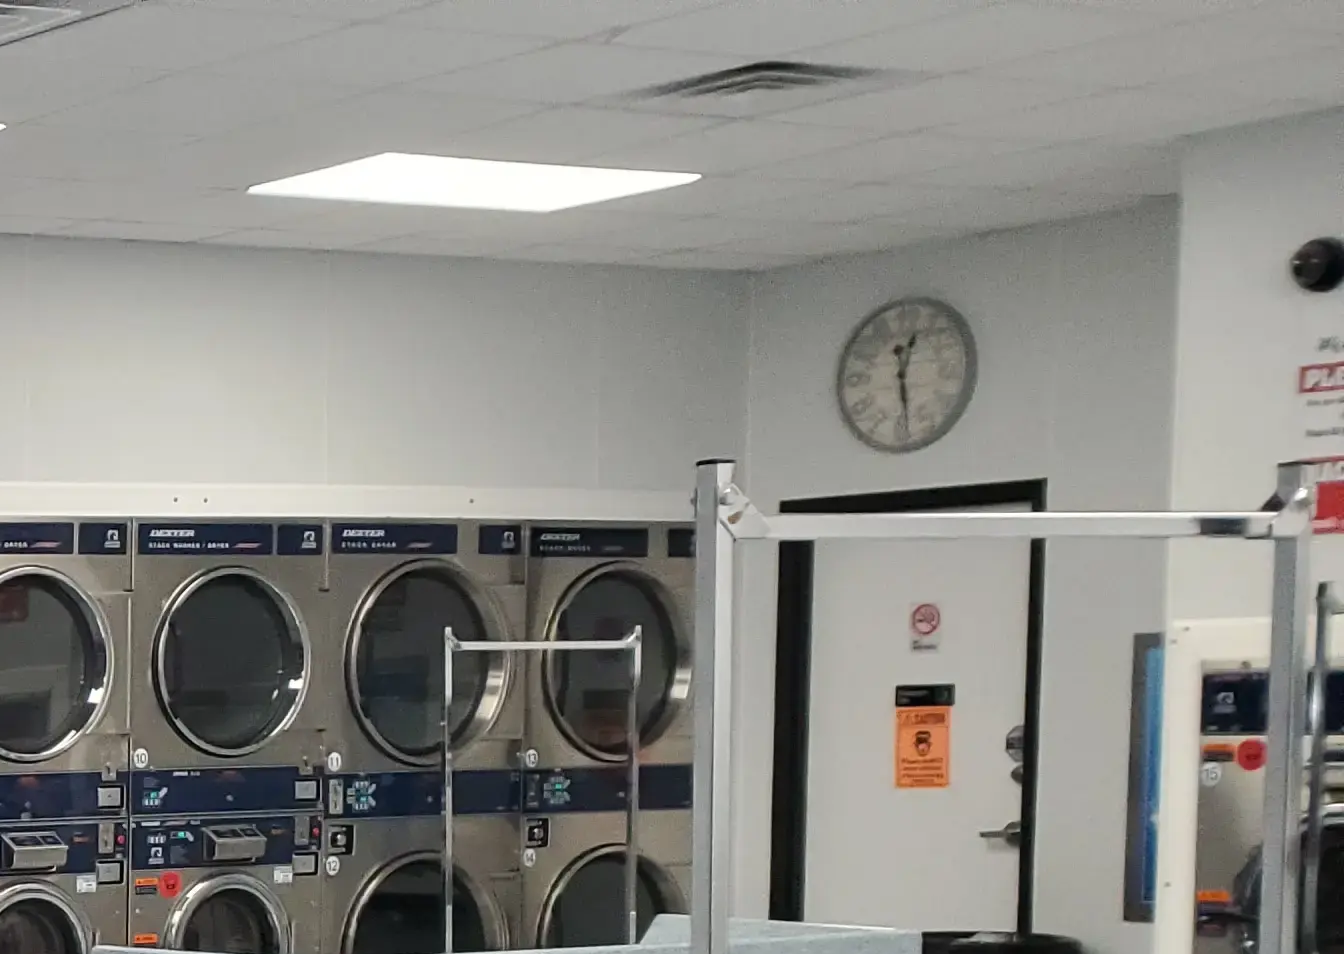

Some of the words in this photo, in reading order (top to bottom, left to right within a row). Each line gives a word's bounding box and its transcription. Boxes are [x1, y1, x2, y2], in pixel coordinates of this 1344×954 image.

[136, 752, 146, 764] 10
[329, 756, 339, 767] 11
[1204, 767, 1218, 781] 15
[327, 860, 339, 871] 12
